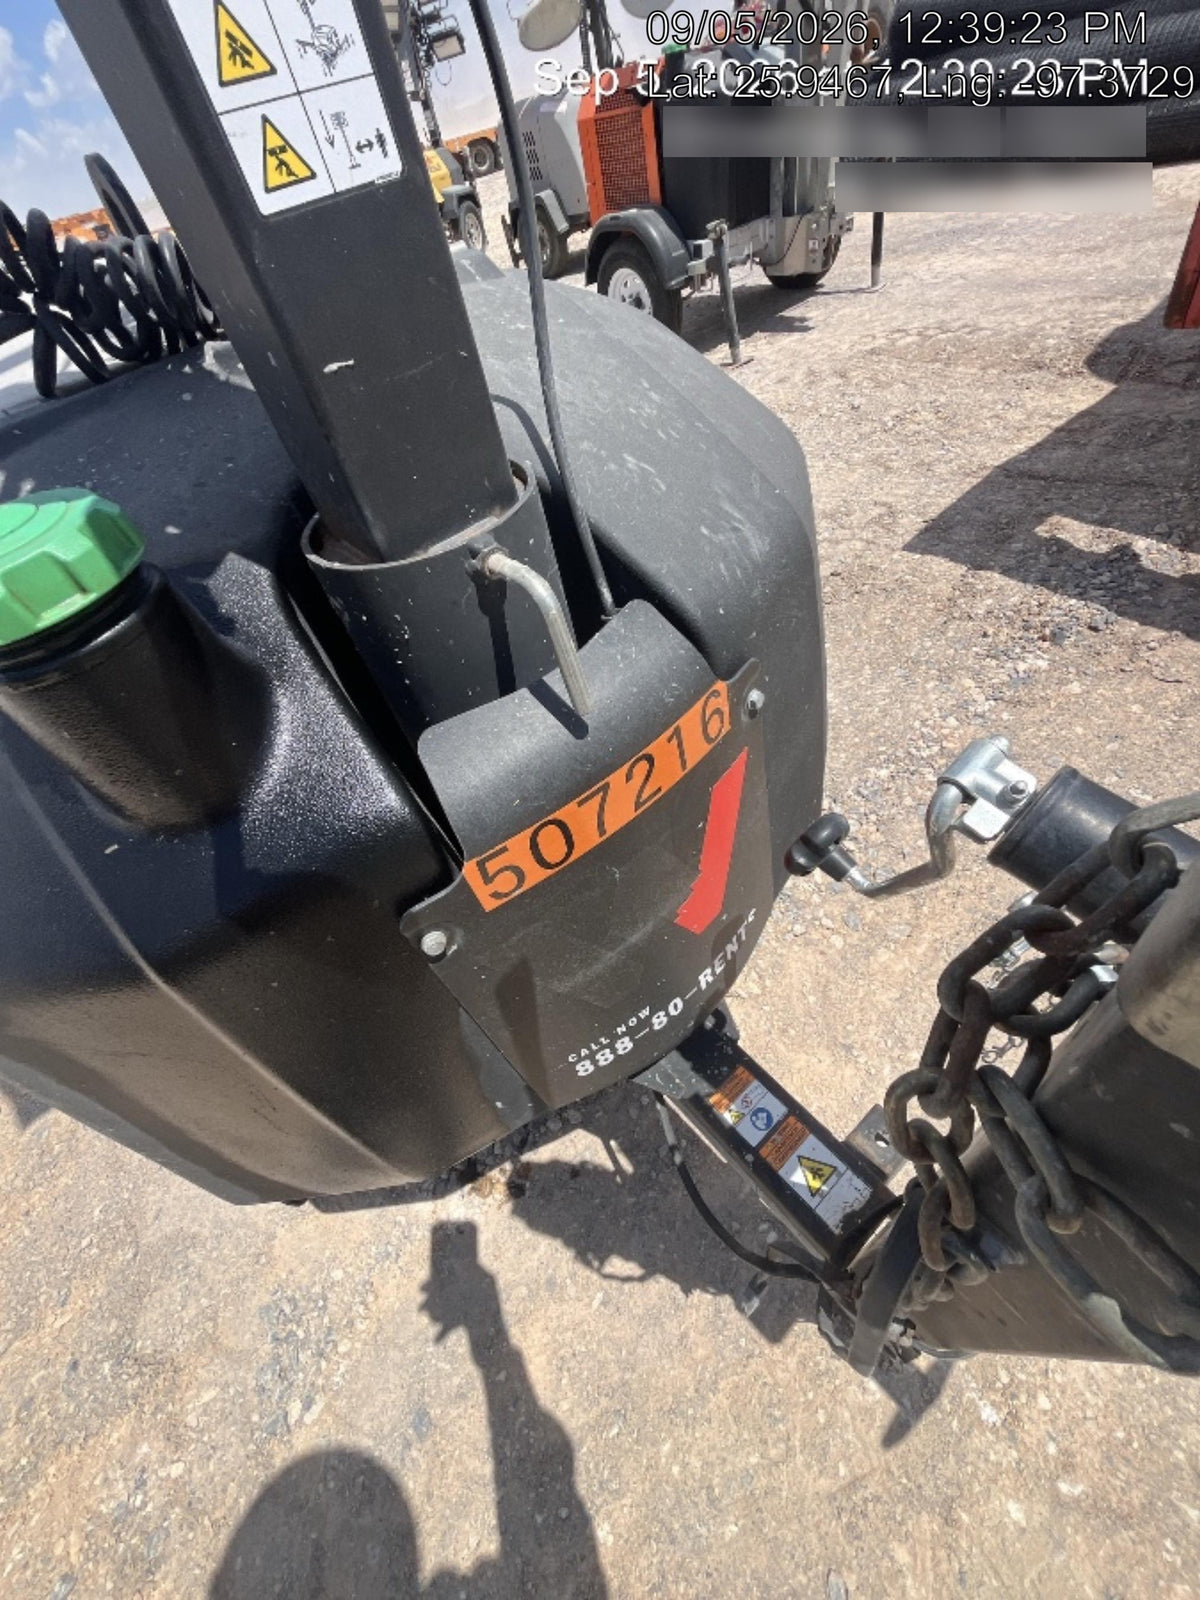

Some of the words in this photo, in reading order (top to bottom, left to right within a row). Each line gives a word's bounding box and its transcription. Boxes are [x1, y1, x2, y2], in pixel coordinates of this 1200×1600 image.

[476, 688, 726, 900] 507216
[567, 1036, 611, 1063] CALL
[615, 1005, 651, 1036] NOW
